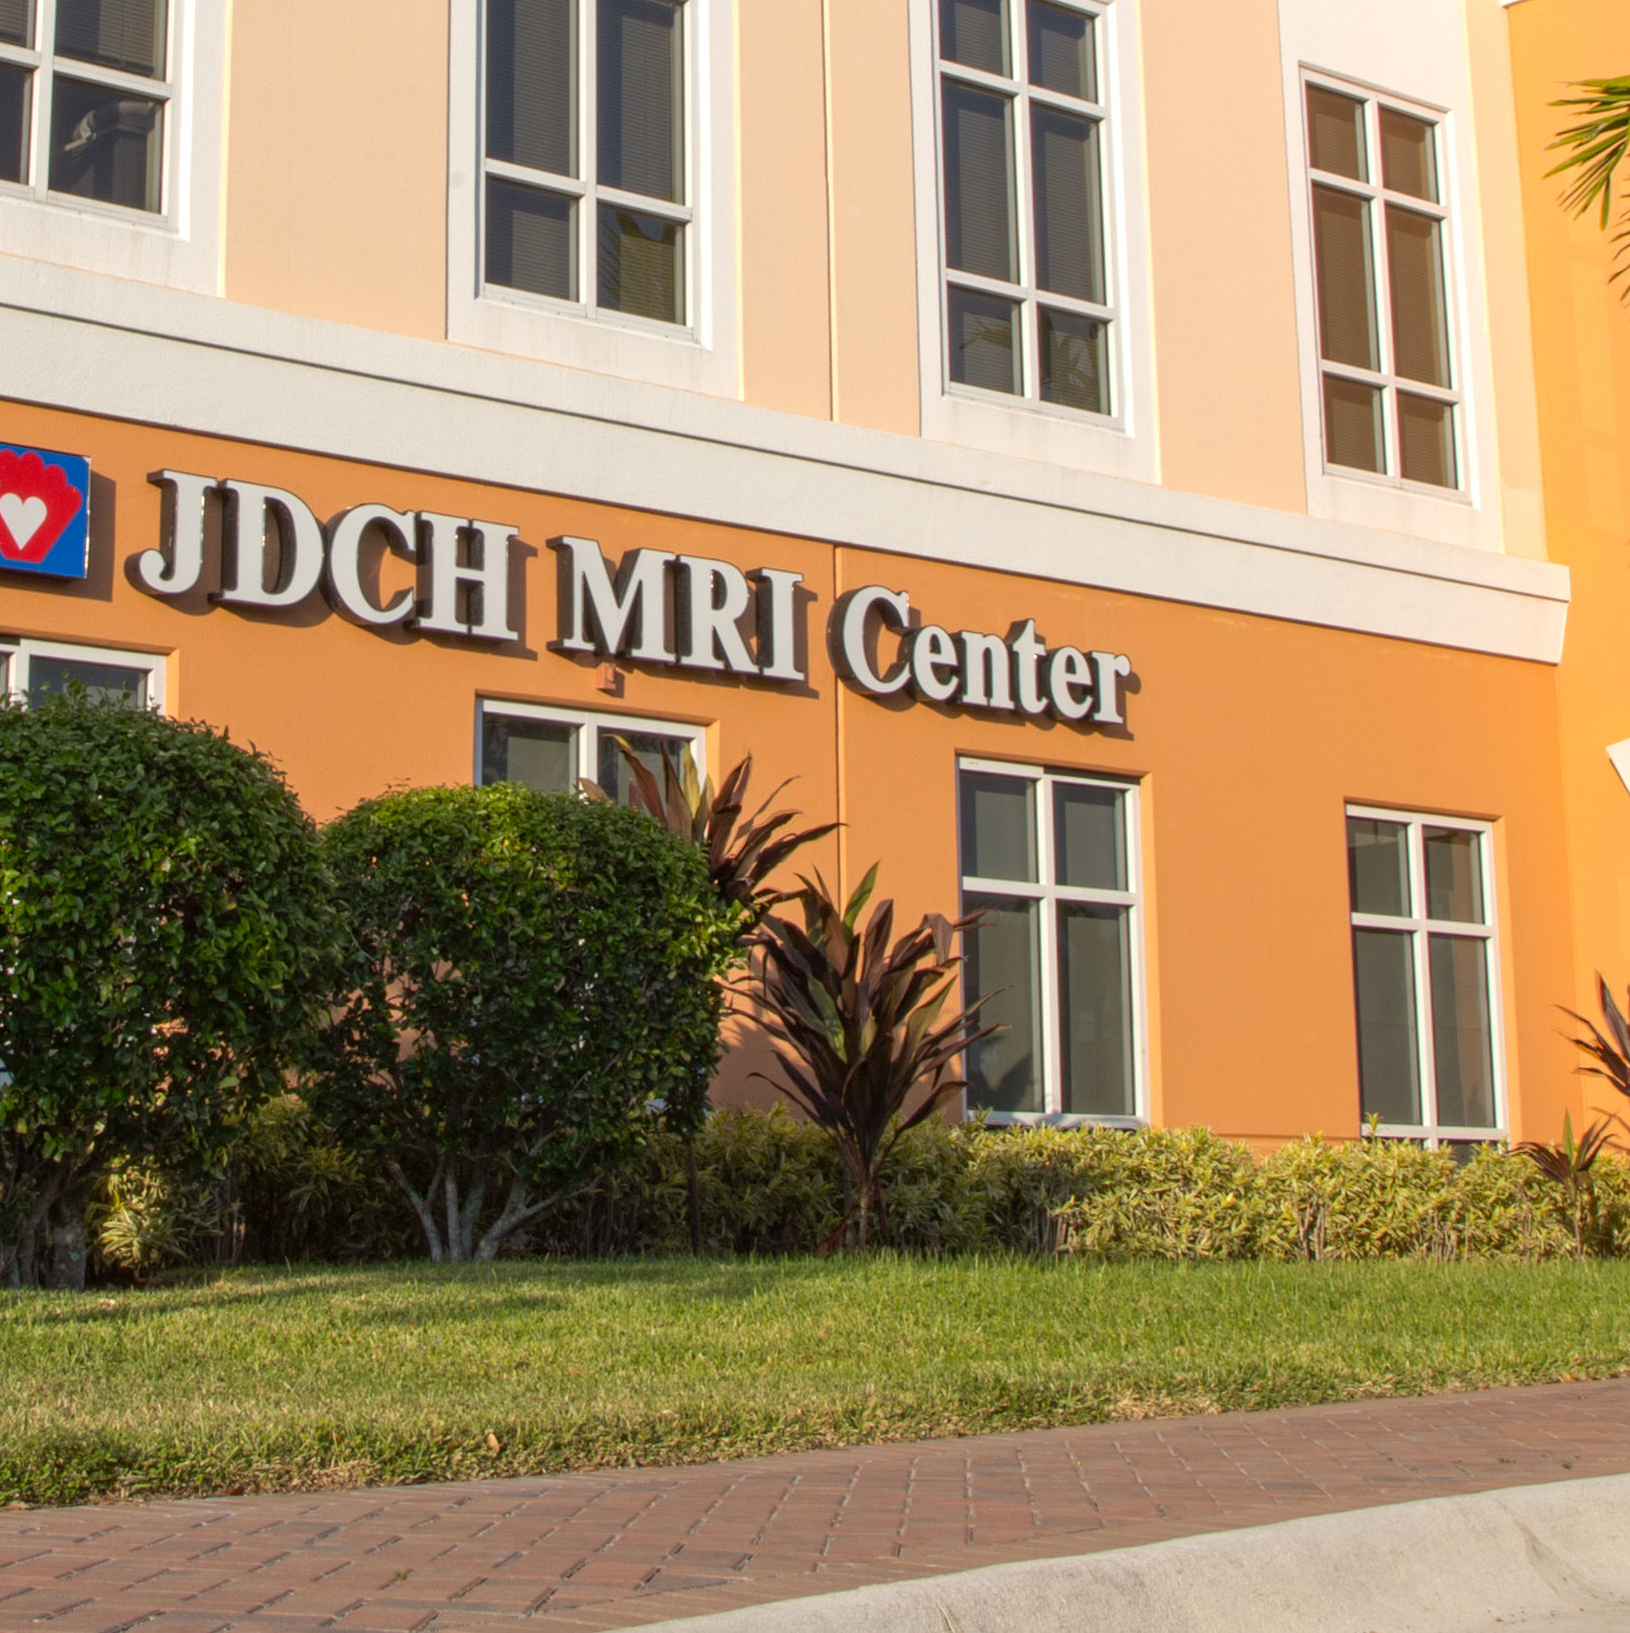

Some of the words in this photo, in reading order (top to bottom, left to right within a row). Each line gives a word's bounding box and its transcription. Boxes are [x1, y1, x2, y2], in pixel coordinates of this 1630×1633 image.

[134, 468, 520, 640] JDCH
[555, 534, 805, 681] MRI
[835, 584, 1131, 724] Center
